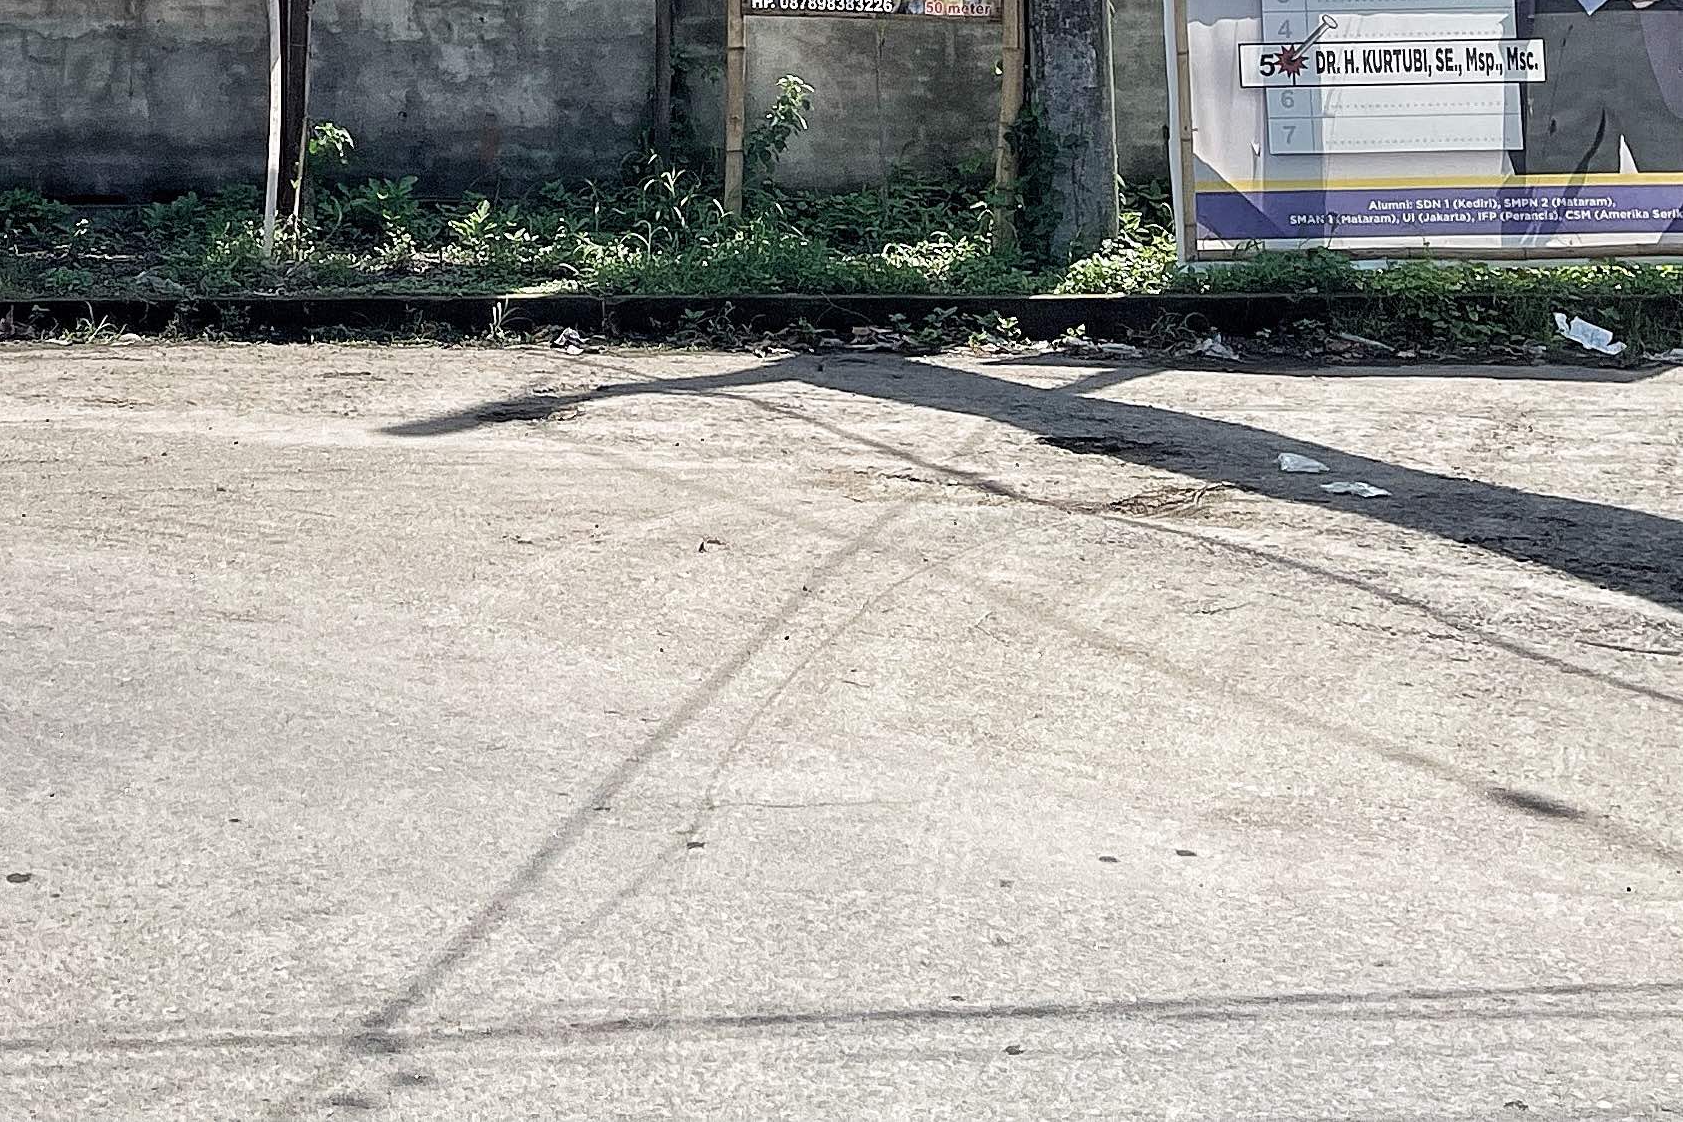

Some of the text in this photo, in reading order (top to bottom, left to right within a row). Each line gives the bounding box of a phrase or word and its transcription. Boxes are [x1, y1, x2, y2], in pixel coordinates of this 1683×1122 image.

[925, 0, 992, 16] 50 meter
[1368, 199, 1413, 211] Alumni:
[1416, 199, 1441, 209] SDN
[1504, 197, 1538, 208] SMPN
[1541, 198, 1548, 207] 2
[1551, 196, 1616, 209] (Mataram),
